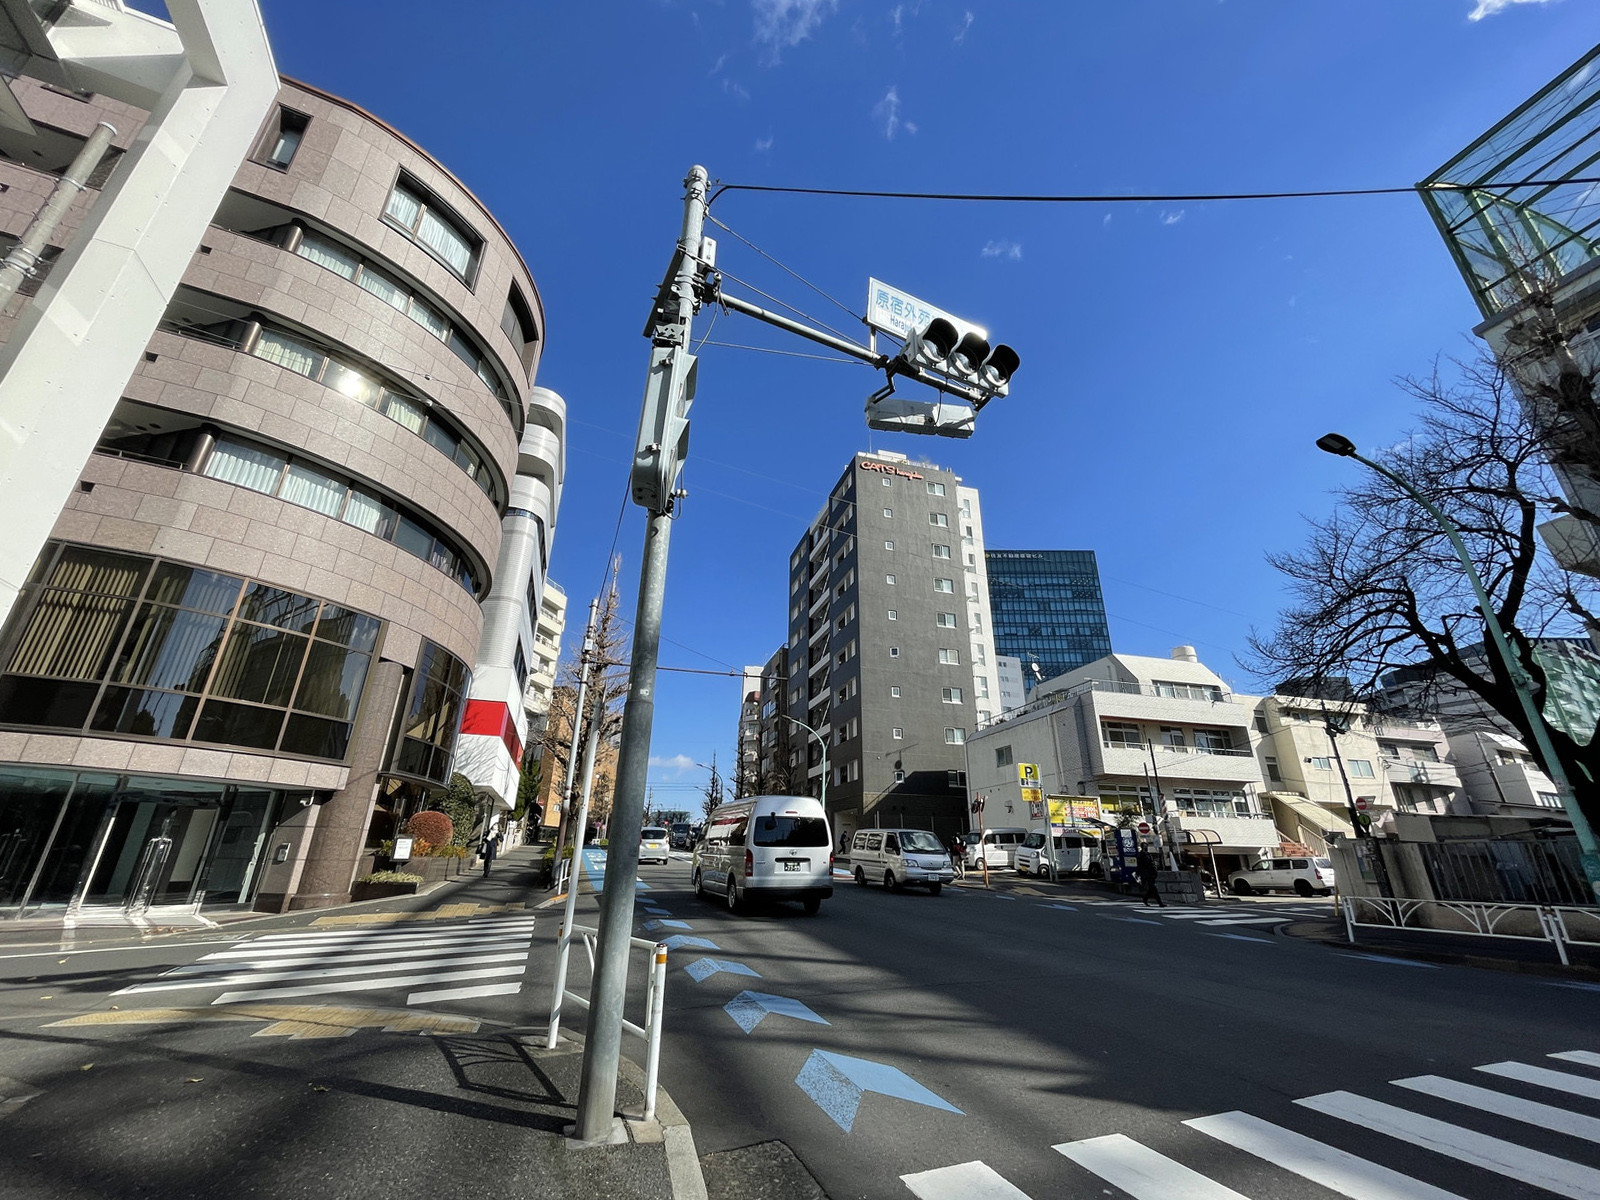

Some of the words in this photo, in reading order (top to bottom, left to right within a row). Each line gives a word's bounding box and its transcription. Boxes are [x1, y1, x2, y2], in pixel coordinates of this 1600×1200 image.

[876, 289, 936, 324] 原宿外苑
[861, 461, 895, 474] CATS
[1025, 766, 1033, 777] P
